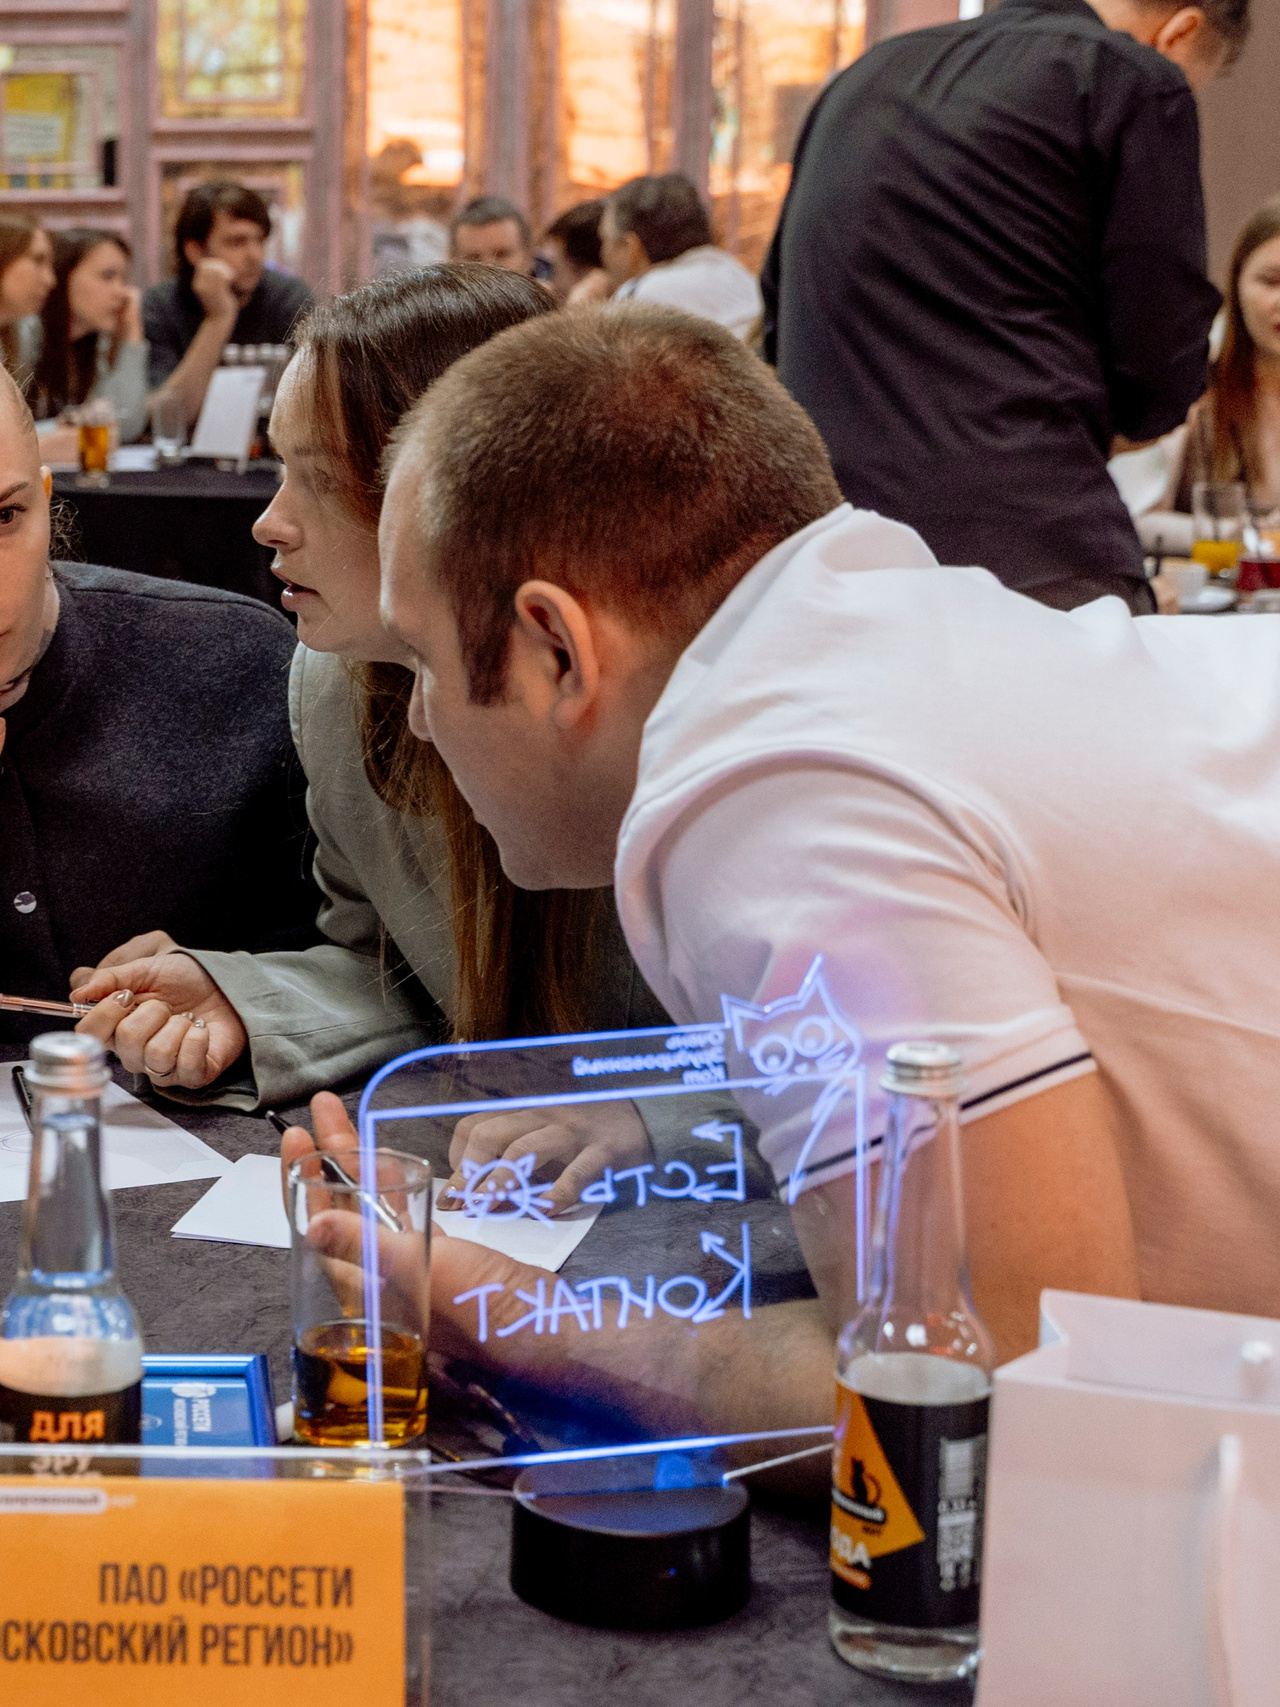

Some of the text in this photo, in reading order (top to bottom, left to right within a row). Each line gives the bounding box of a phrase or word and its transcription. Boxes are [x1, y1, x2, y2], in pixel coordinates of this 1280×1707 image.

[29, 1409, 106, 1443] ДЛЯ
[98, 1563, 354, 1608] ПАО «РОССЕТИ
[200, 1622, 354, 1667] РЕГИОН»
